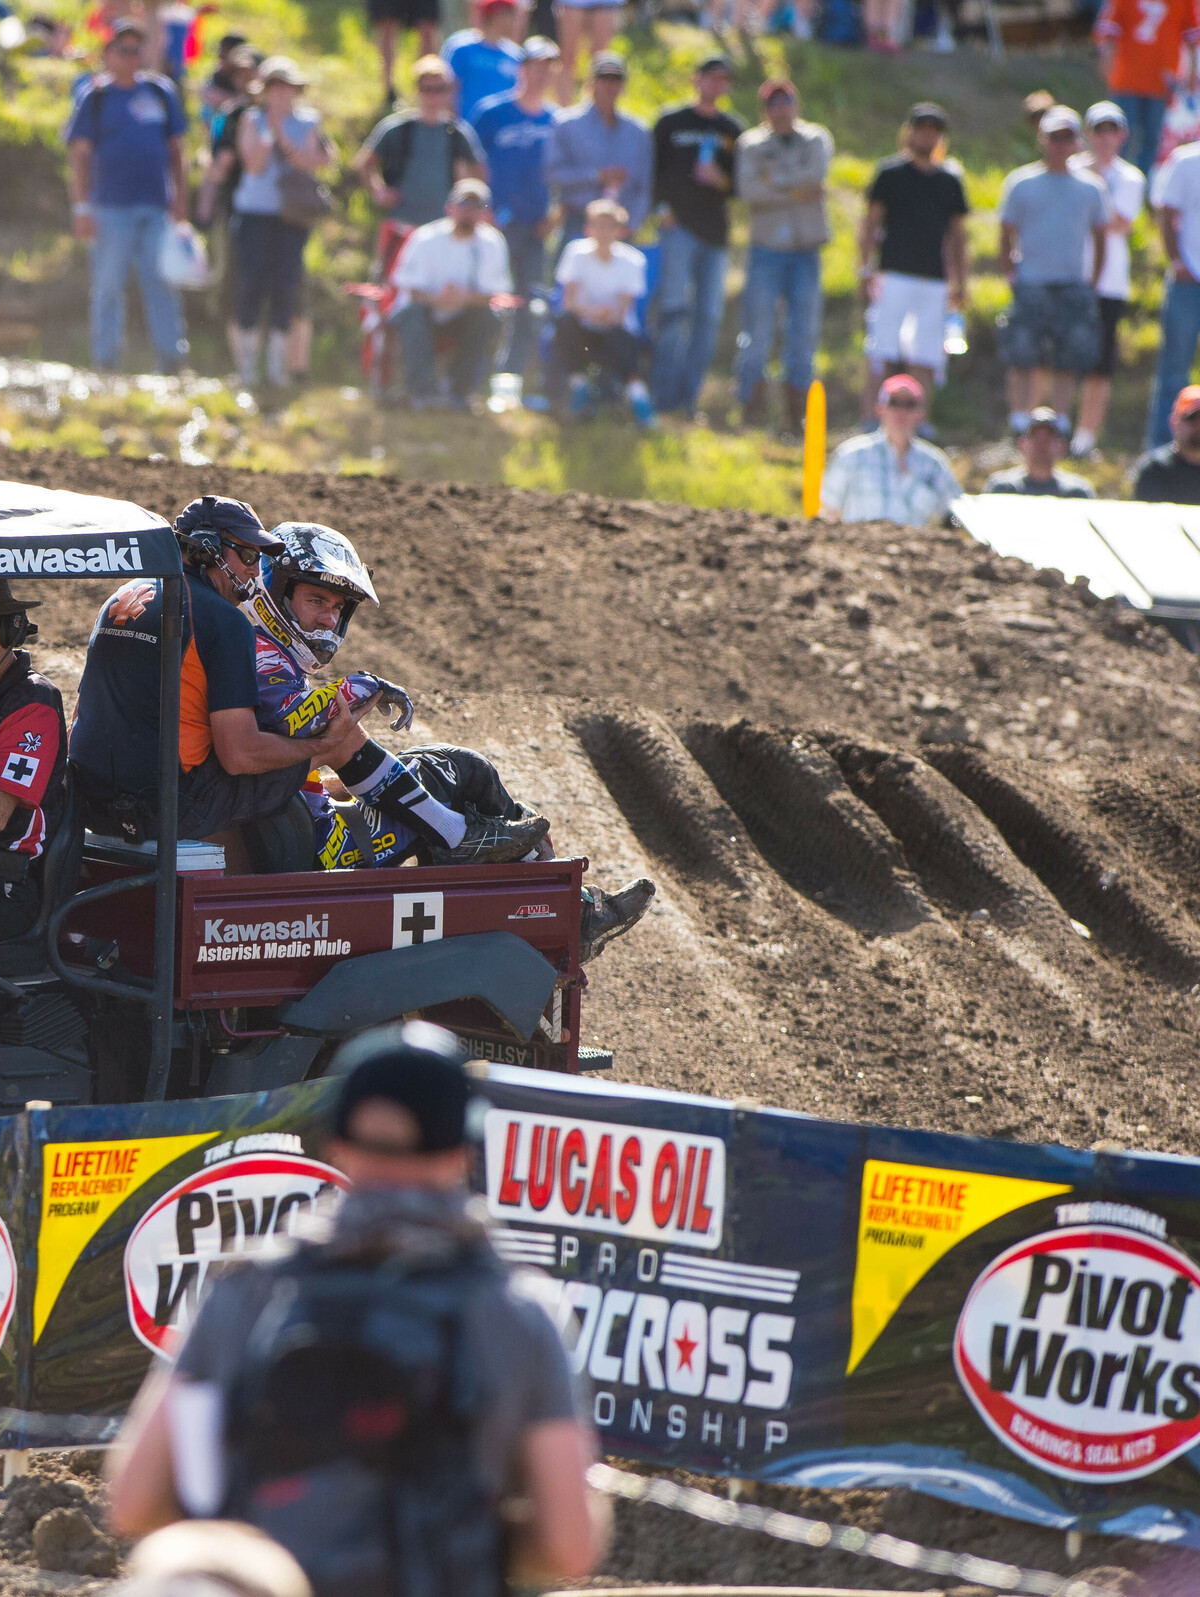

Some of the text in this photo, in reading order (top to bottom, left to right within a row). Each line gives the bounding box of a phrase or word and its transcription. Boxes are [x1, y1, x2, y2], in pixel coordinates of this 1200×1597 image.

[105, 627, 135, 638] MOTOCROSS
[134, 631, 157, 644] MEDICS
[255, 597, 292, 648] GEICO
[340, 832, 397, 867] GECO
[515, 904, 550, 918] 4WD
[204, 914, 329, 944] Kawasaki
[197, 938, 351, 962] Asterisk Medic Mule
[53, 1148, 141, 1178] LIFETIME
[203, 1132, 305, 1165] THE ORIGINAL
[50, 1178, 132, 1198] REPLACEMENT
[498, 1121, 713, 1234] LUCAS OIL
[870, 1173, 969, 1211] LIFETIME
[47, 1200, 100, 1217] PROGRAM
[1055, 1200, 1168, 1240] THE ORIGINAL
[560, 1235, 659, 1283] PRO
[1020, 1253, 1194, 1341] Pivot
[989, 1323, 1200, 1421] Works
[1009, 1413, 1073, 1462] BEARING
[1085, 1444, 1121, 1465] SEAL
[1122, 1434, 1156, 1463] KITS
